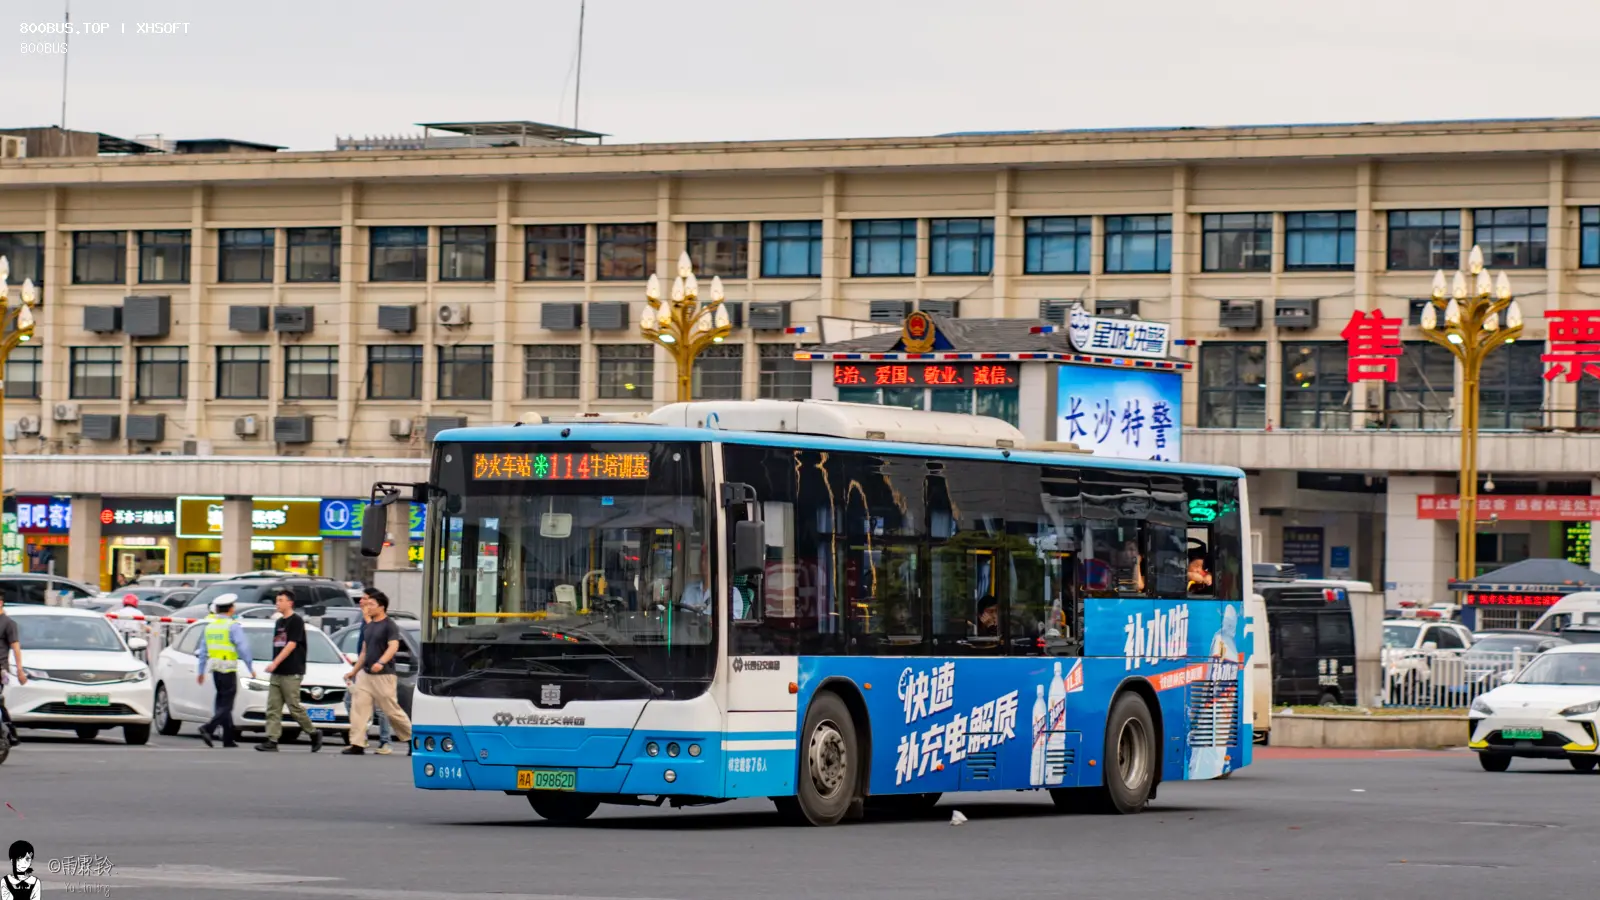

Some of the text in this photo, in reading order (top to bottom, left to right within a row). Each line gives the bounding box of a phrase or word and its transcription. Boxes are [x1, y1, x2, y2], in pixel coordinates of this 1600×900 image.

[1064, 396, 1173, 449] 长沙特警
[549, 453, 591, 479] 114
[1124, 603, 1188, 670] 补水啦
[904, 661, 955, 724] 快速
[895, 690, 1019, 786] 补充电解质
[439, 766, 462, 779] 6914
